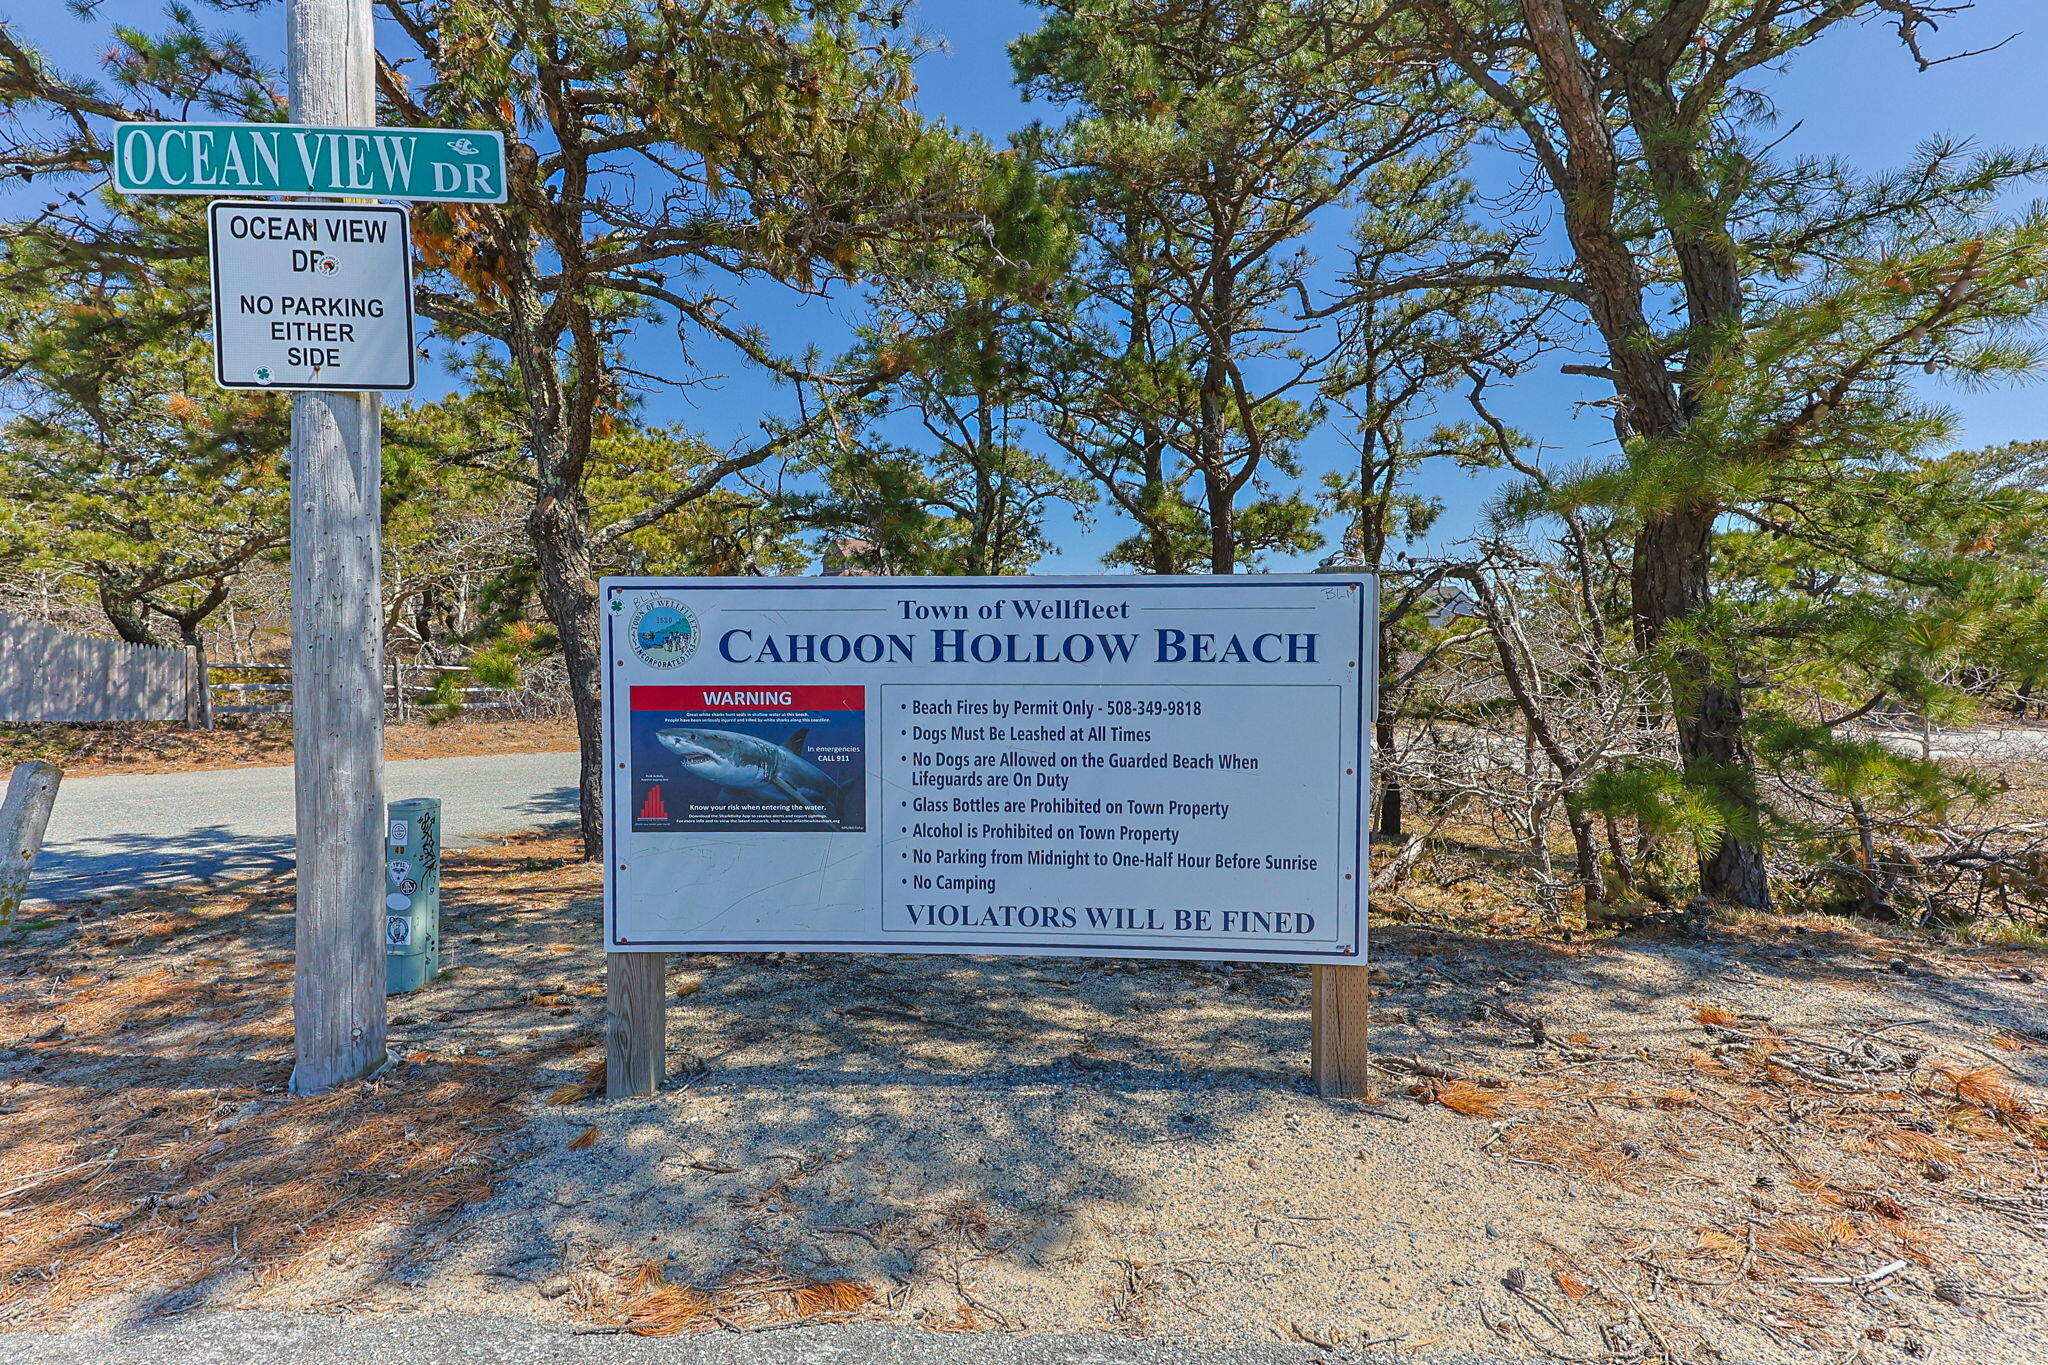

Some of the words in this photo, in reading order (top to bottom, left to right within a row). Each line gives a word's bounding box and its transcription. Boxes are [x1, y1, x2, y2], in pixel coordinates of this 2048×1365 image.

[124, 130, 280, 186] OCEAN
[293, 130, 417, 191] VIEW
[431, 162, 495, 193] DR
[231, 216, 317, 241] OCEAN
[325, 219, 386, 243] VIEW
[241, 296, 273, 314] NO
[282, 297, 383, 317] PARKING
[272, 322, 354, 342] EITHER
[288, 348, 340, 367] SIDE
[1321, 586, 1357, 603] BLM
[631, 609, 645, 630] TOWN
[657, 600, 699, 629] WELLFLEET
[898, 601, 967, 619] Town
[979, 600, 1006, 619] of
[1012, 600, 1129, 619] Wellfleet
[719, 629, 915, 663] CAHOON
[931, 630, 1139, 663] HOLLOW
[1154, 629, 1319, 663] BEACH
[634, 646, 687, 669] INCORPORATED
[703, 692, 791, 705] WARNING
[913, 699, 951, 714] Beach
[958, 700, 988, 714] Fires
[993, 699, 1009, 718] by
[1015, 700, 1058, 714] Permit
[1063, 700, 1093, 719] Only
[1108, 701, 1201, 715] 508-349-9818
[914, 726, 946, 744] Dogs
[952, 727, 984, 740] Must
[990, 727, 1005, 740] Be
[1011, 726, 1065, 741] Leashed
[1070, 728, 1083, 741] at
[1088, 726, 1105, 741] All
[1111, 727, 1150, 741] Times
[815, 746, 861, 754] emergencies
[914, 752, 931, 766] No
[937, 753, 969, 770] Dogs
[974, 756, 995, 766] are
[1000, 752, 1055, 767] Allowed
[1061, 757, 1077, 767] on
[1082, 753, 1104, 767] the
[1109, 753, 1167, 768] Guarded
[1174, 754, 1213, 768] Beach
[1219, 754, 1258, 769] When
[913, 771, 982, 790] Lifeguards
[987, 776, 1008, 786] are
[1014, 773, 1031, 786] On
[1037, 773, 1068, 791] Duty
[727, 803, 740, 811] risk
[741, 803, 761, 811] when
[761, 804, 791, 812] entering
[913, 797, 948, 812] Glass
[954, 797, 999, 812] Bottles
[1004, 802, 1025, 812] are
[1031, 798, 1100, 813] Prohibited
[1106, 803, 1122, 813] on
[1127, 800, 1163, 814] Town
[1170, 801, 1229, 819] Property
[913, 823, 962, 837] Alcohol
[968, 823, 977, 838] is
[983, 824, 1052, 839] Prohibited
[1058, 829, 1073, 839] on
[1079, 826, 1114, 839] Town
[1121, 826, 1179, 845] Property
[914, 849, 931, 863] No
[937, 849, 986, 868] Parking
[991, 849, 1022, 864] from
[1028, 850, 1089, 869] Midnight
[1094, 853, 1107, 865] to
[1113, 852, 1173, 867] One-Half
[1178, 853, 1210, 867] Hour
[1216, 853, 1260, 869] Before
[1266, 855, 1317, 870] Sunrise
[914, 875, 931, 889] No
[937, 875, 995, 894] Camping
[905, 906, 1076, 928] VIOLATORS
[1084, 908, 1164, 930] WILL
[1174, 910, 1211, 931] BE
[1222, 911, 1314, 933] FINED
